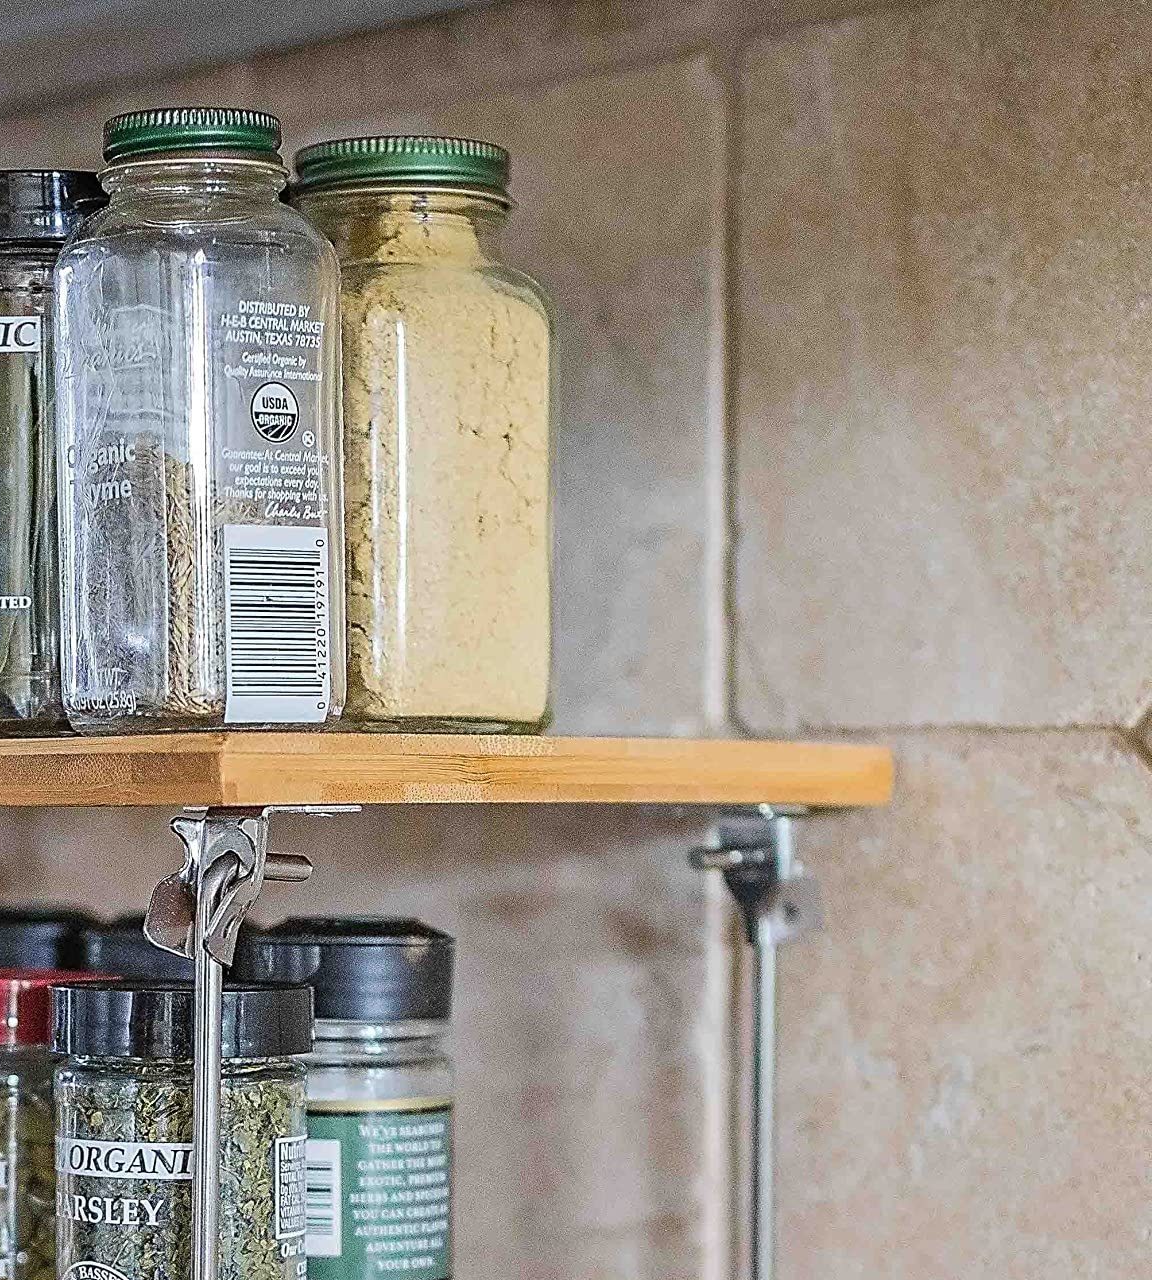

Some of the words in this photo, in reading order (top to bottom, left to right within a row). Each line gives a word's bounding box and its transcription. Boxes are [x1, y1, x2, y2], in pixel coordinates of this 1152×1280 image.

[239, 300, 296, 316] DISTRIBUTED
[298, 306, 310, 318] BY
[248, 317, 288, 331] CENTRAL
[290, 321, 325, 334] MARKET
[225, 330, 263, 345] AUSTIN,
[265, 332, 293, 346] TEXAS
[295, 334, 321, 348] 78735
[272, 353, 298, 368] Organic
[298, 356, 307, 368] by
[262, 396, 288, 410] USDA
[258, 414, 293, 426] ORGANIC
[67, 438, 137, 475] Oganic
[274, 450, 302, 462] Central
[229, 463, 244, 473] our
[244, 462, 262, 475] goal
[263, 463, 270, 474] is
[270, 464, 279, 474] to
[280, 464, 307, 475] exceed
[307, 468, 323, 480] you
[235, 475, 283, 488] expectations
[283, 479, 304, 491] every
[69, 479, 133, 509] yme
[225, 486, 254, 499] Thanks
[254, 487, 267, 501] for
[268, 489, 300, 504] shopping
[301, 491, 318, 502] with
[69, 1144, 194, 1174] ORGANI
